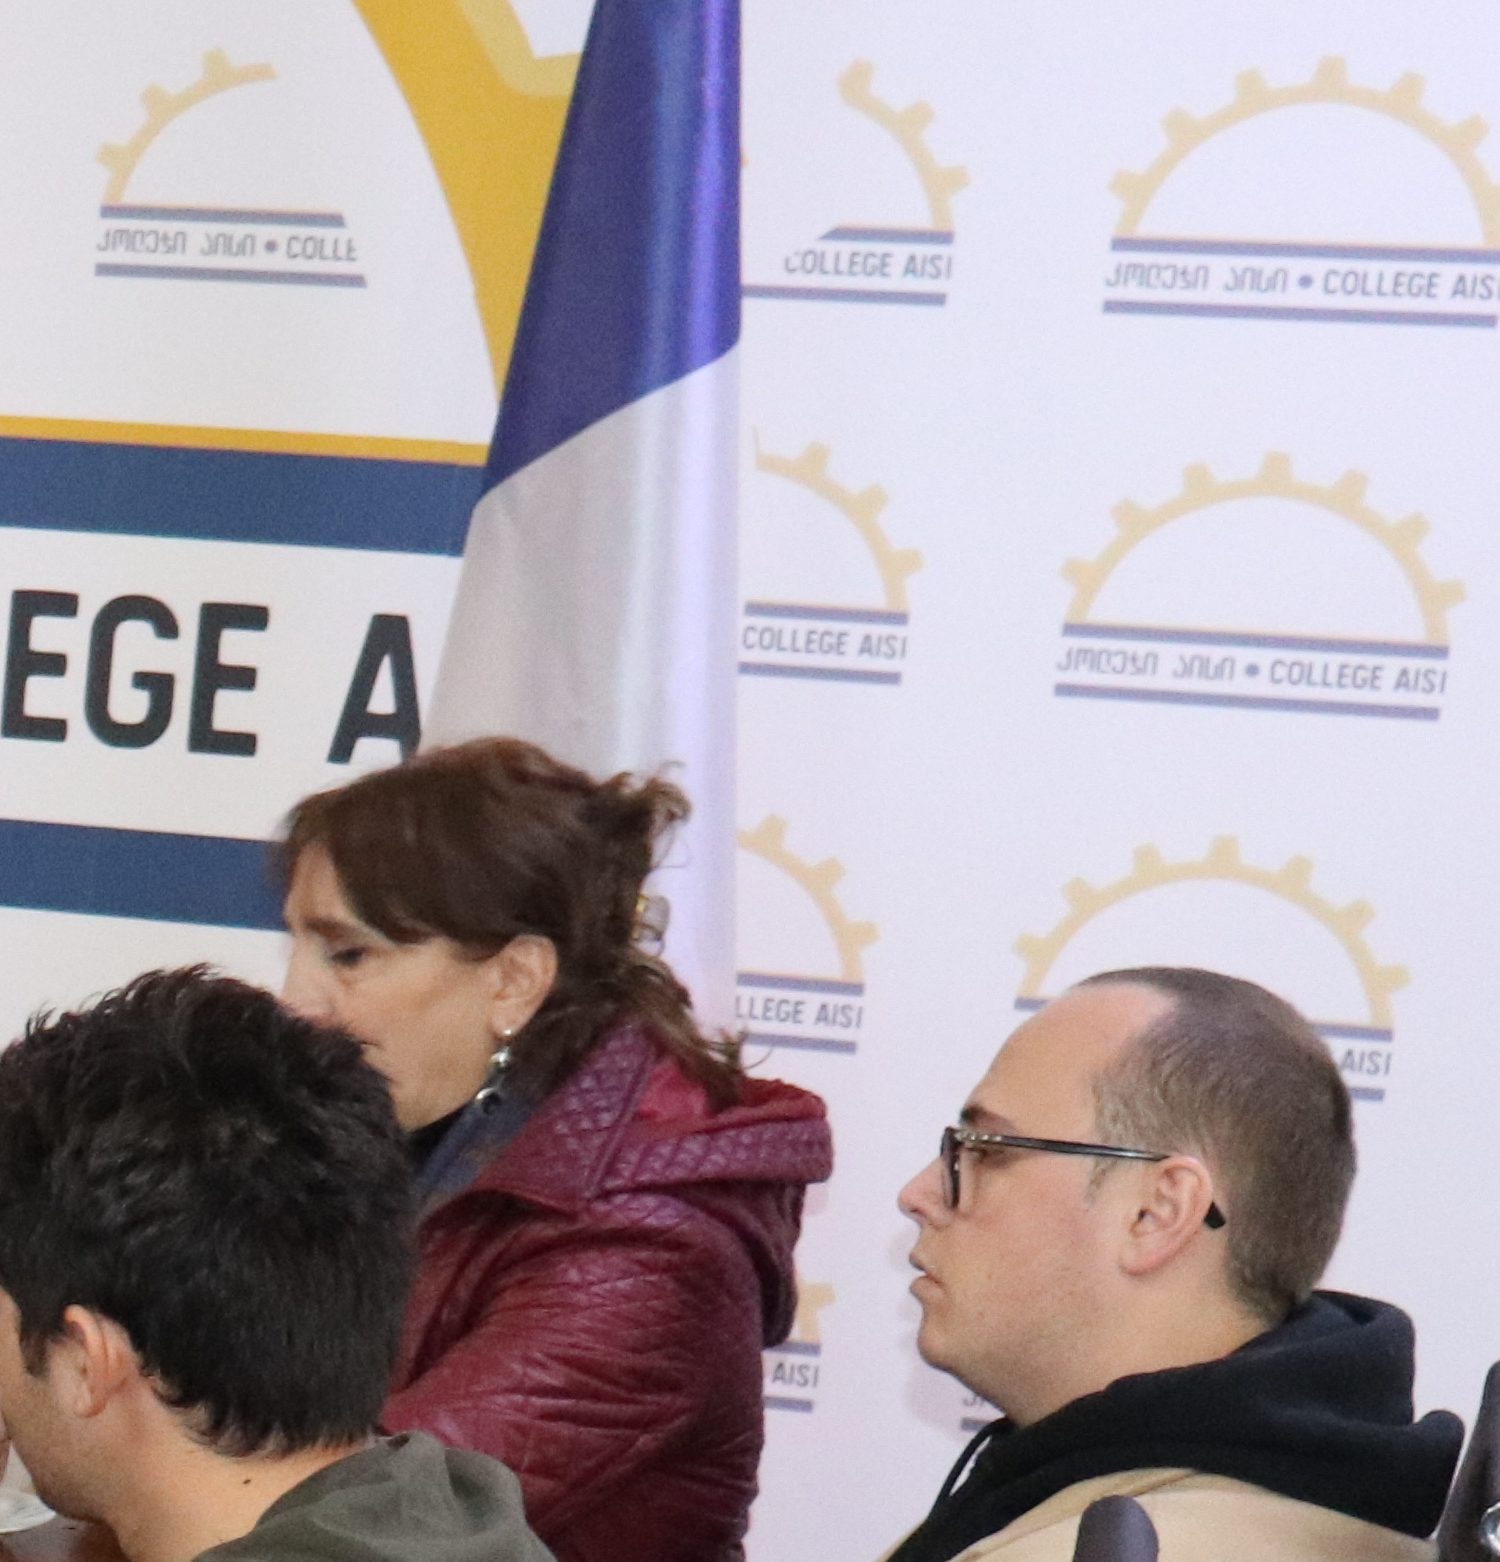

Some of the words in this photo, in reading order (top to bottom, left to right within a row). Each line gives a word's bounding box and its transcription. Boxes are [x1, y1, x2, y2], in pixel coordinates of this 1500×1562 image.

[902, 253, 953, 280] AISI
[1322, 268, 1439, 299] COLLEGE
[743, 626, 849, 655] COLLEGE
[857, 633, 907, 660] AISI
[1269, 658, 1385, 690] COLLEGE
[1394, 668, 1448, 695] AISI
[736, 997, 804, 1024] LLEGE
[814, 1002, 864, 1029] AISI
[1340, 1048, 1392, 1077] AISI
[771, 1361, 820, 1388] AISI
